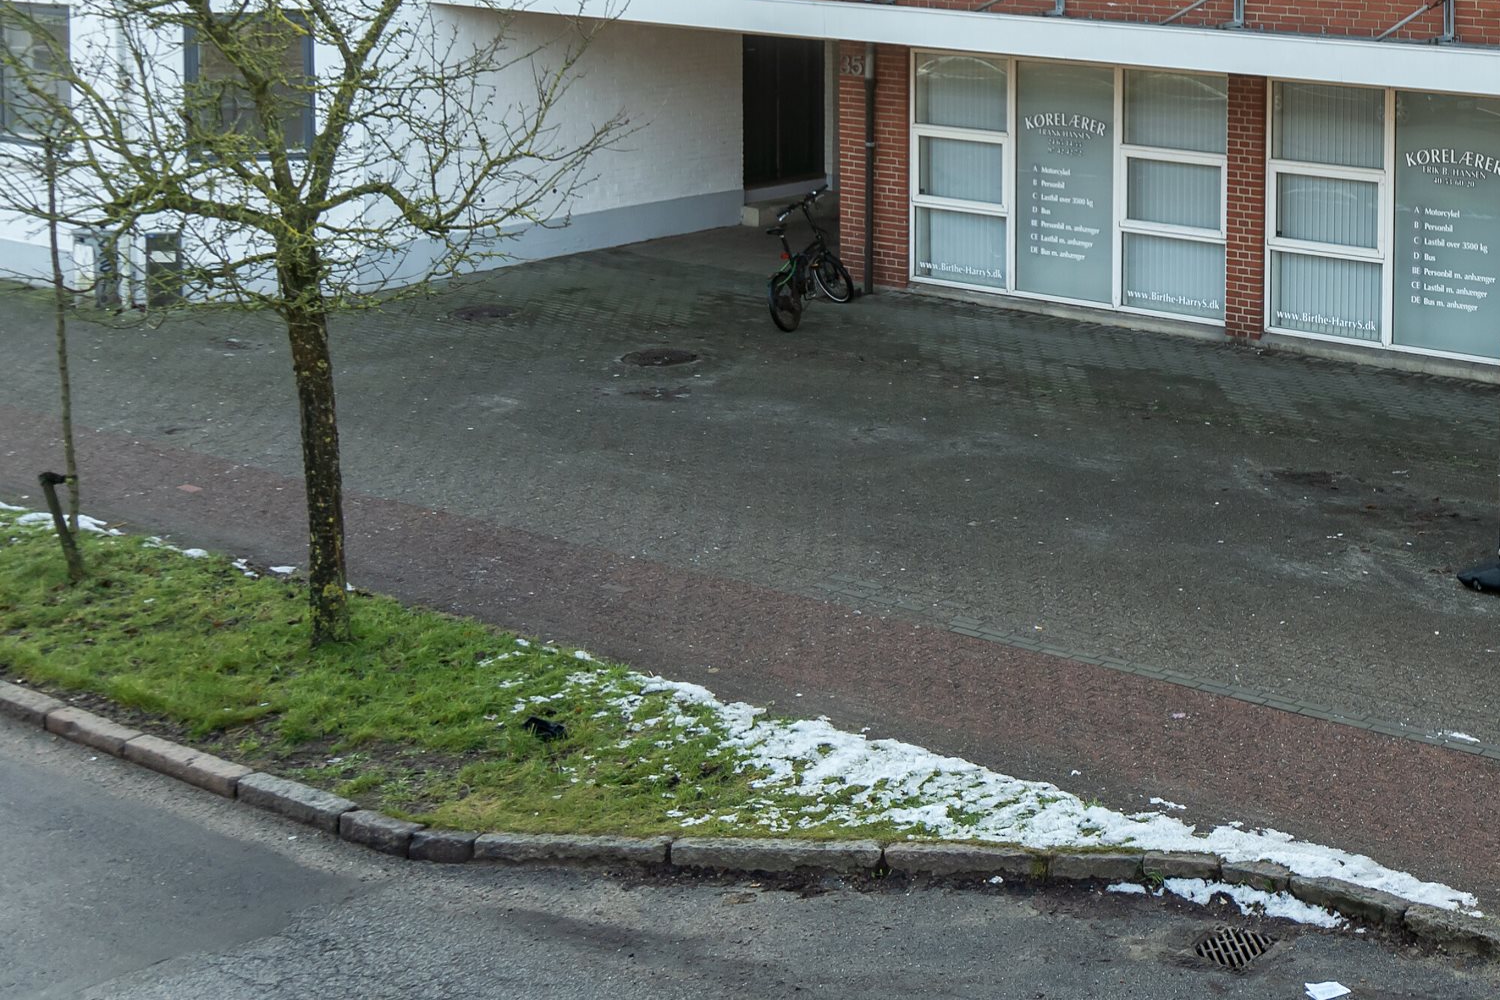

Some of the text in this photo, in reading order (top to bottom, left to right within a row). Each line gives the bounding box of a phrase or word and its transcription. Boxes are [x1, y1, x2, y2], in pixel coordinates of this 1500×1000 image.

[1025, 112, 1106, 137] KØRELÆRER
[1422, 166, 1439, 176] ERIK
[1452, 169, 1486, 180] HANSEN
[1414, 206, 1460, 219] A Motorcykel
[1414, 221, 1453, 232] B Personbil
[1424, 238, 1445, 248] Lastbil
[1462, 242, 1479, 251] 3500
[1480, 243, 1488, 254] kg
[1424, 253, 1436, 261] Bus
[919, 261, 1003, 279] www.Birthe-HarryS.dk
[1424, 268, 1452, 279] Personbil
[1411, 281, 1420, 289] CE
[1424, 283, 1444, 293] Lastbil
[1127, 290, 1219, 310] www.Birthe-HarryS.dk
[1411, 296, 1420, 304] DE
[1423, 298, 1435, 306] Bus
[1276, 310, 1376, 331] www.Birthe-HarryS.dk
